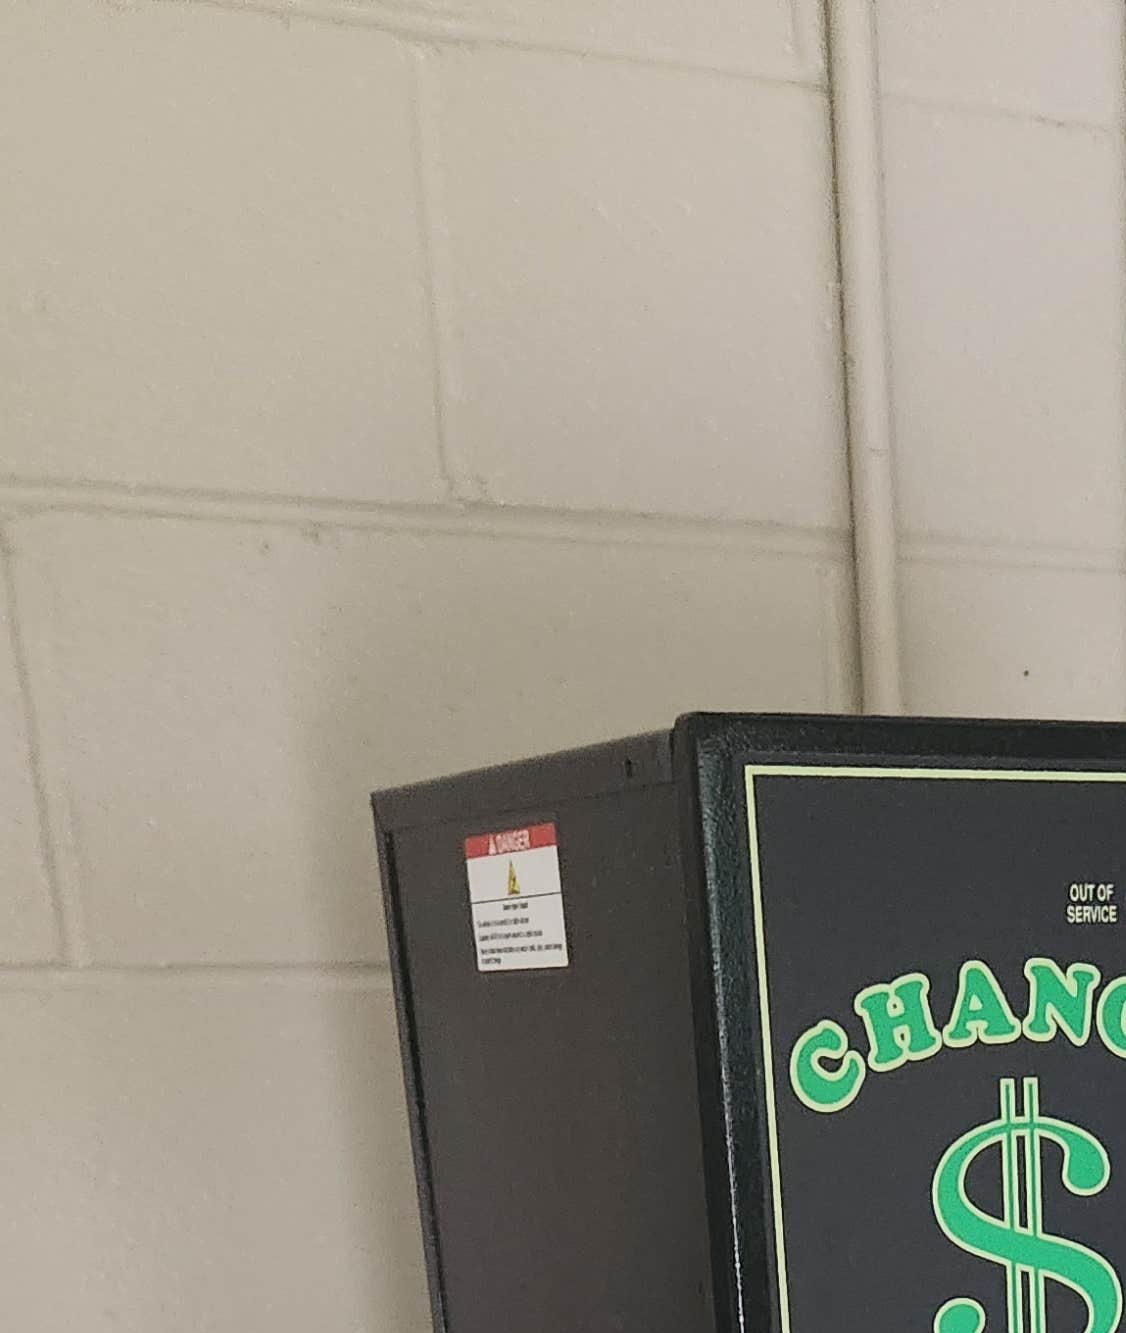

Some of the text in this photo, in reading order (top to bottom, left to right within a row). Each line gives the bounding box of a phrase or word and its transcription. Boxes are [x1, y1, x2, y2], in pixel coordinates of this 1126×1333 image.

[1070, 883, 1114, 901] OUT OF
[1066, 905, 1117, 924] SERVICE
